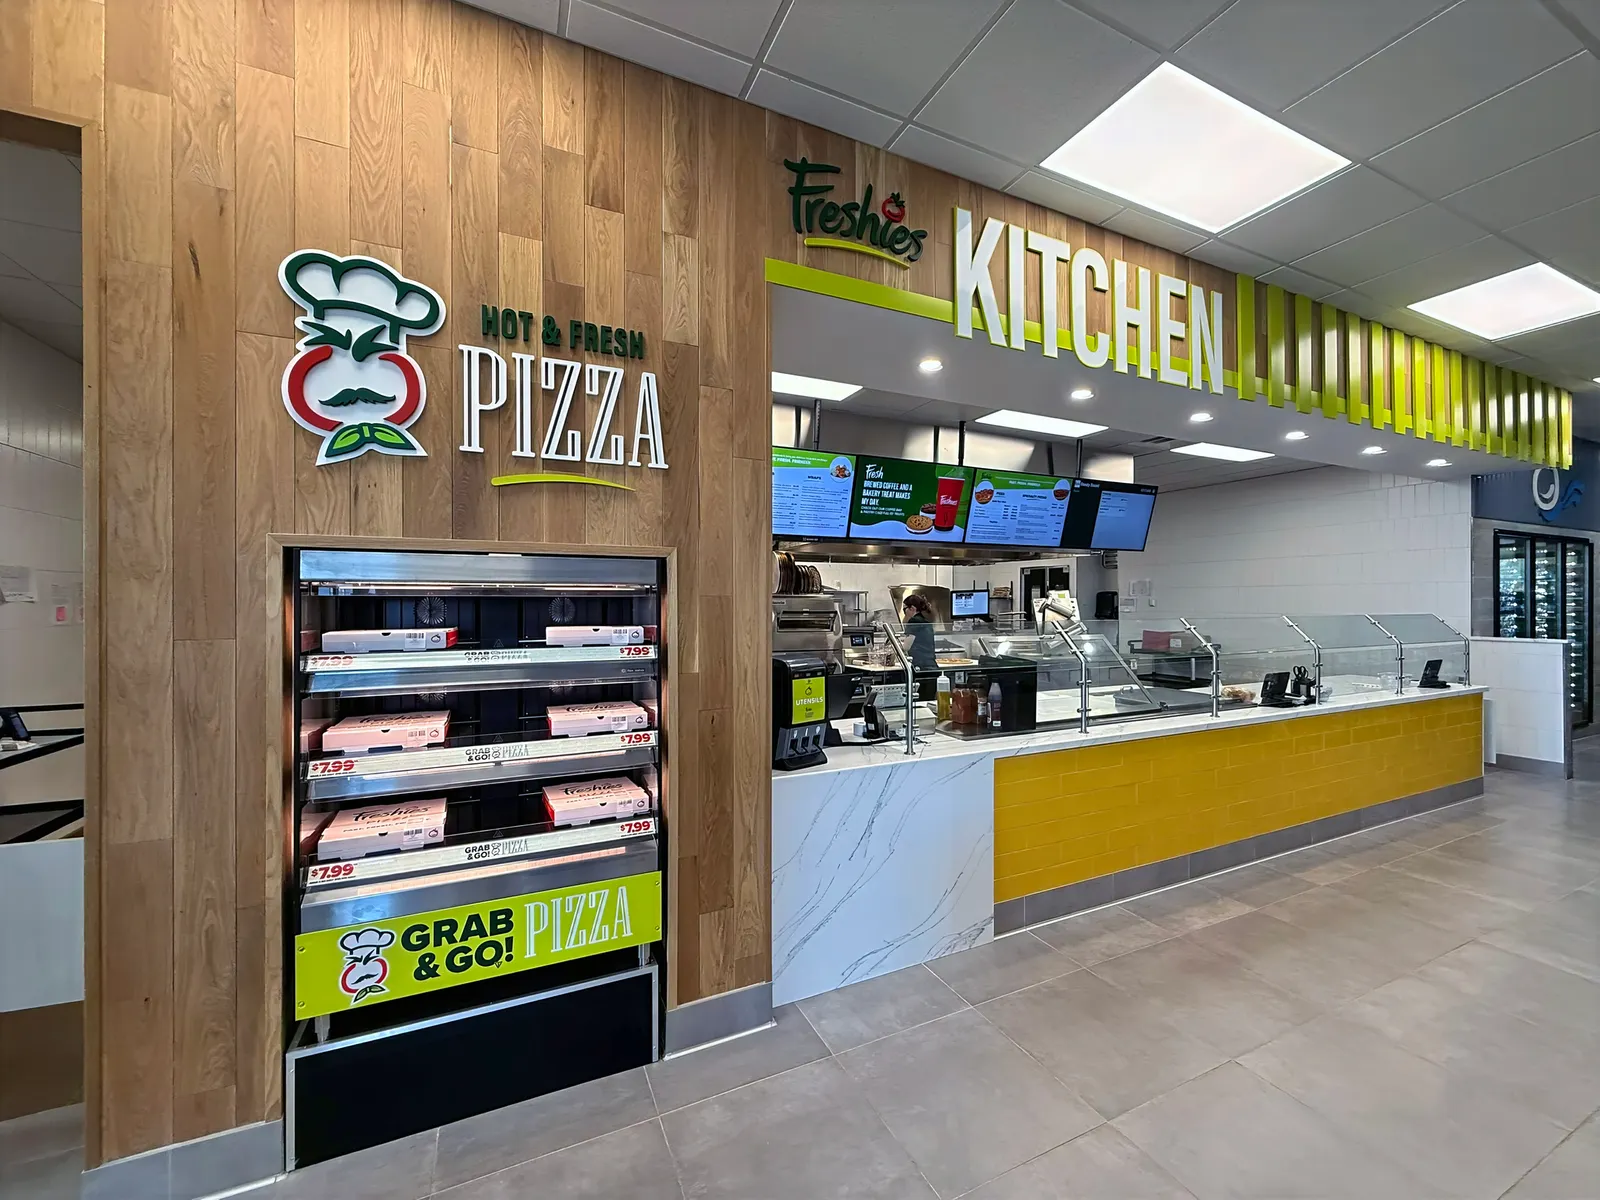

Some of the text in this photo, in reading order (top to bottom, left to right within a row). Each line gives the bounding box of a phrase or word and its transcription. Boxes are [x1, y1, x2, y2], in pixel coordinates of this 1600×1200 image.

[784, 156, 928, 262] Freshies
[953, 204, 1224, 395] KITCHEN
[481, 304, 644, 360] HOT & FRESH
[458, 344, 669, 469] PIZZA
[865, 464, 884, 480] Fresh
[863, 480, 883, 489] BREWED
[883, 482, 900, 490] COFFEE
[900, 483, 909, 491] AND
[862, 489, 881, 497] BAKERY
[881, 490, 895, 498] TREAT
[619, 646, 650, 656] $7.99
[795, 697, 824, 706] UTENSILS
[620, 733, 651, 745] $7.99
[465, 748, 491, 756] GRAB
[474, 754, 491, 762] GO!
[312, 759, 355, 774] $7.99
[353, 805, 431, 822] Freshies
[620, 821, 651, 834] $7.99
[464, 839, 529, 856] GRAB PIZZA
[467, 851, 491, 861] & GO!
[310, 863, 354, 880] $7.99
[400, 885, 634, 959] GRAB PIZZA
[413, 936, 514, 982] & GO!
